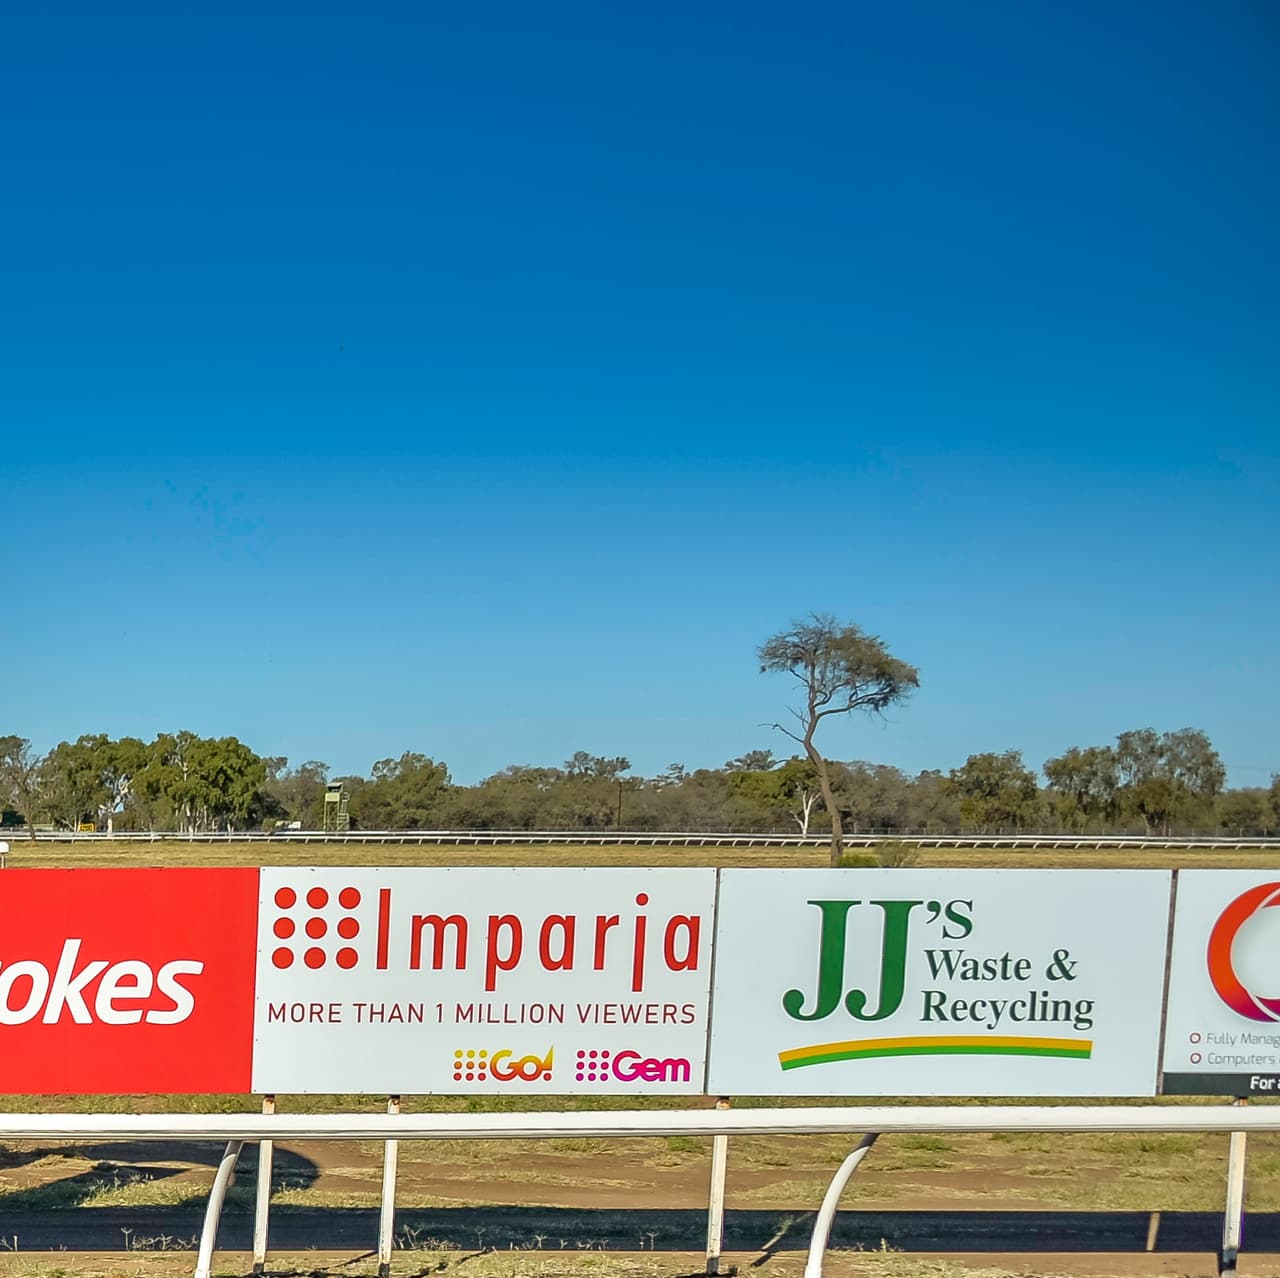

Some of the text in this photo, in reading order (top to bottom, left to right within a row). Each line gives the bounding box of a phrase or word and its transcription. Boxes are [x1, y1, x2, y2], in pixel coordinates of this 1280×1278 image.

[375, 888, 700, 992] Imparja
[924, 949, 1078, 981] Waste &
[268, 1003, 696, 1024] MORE THAN 1 MILLION VIEWERS
[920, 990, 1095, 1029] Recycling
[1206, 1032, 1238, 1047] Fully
[490, 1046, 553, 1081] Go!
[613, 1050, 690, 1082] Gem
[1207, 1052, 1276, 1068] Computers
[1250, 1076, 1276, 1090] For
